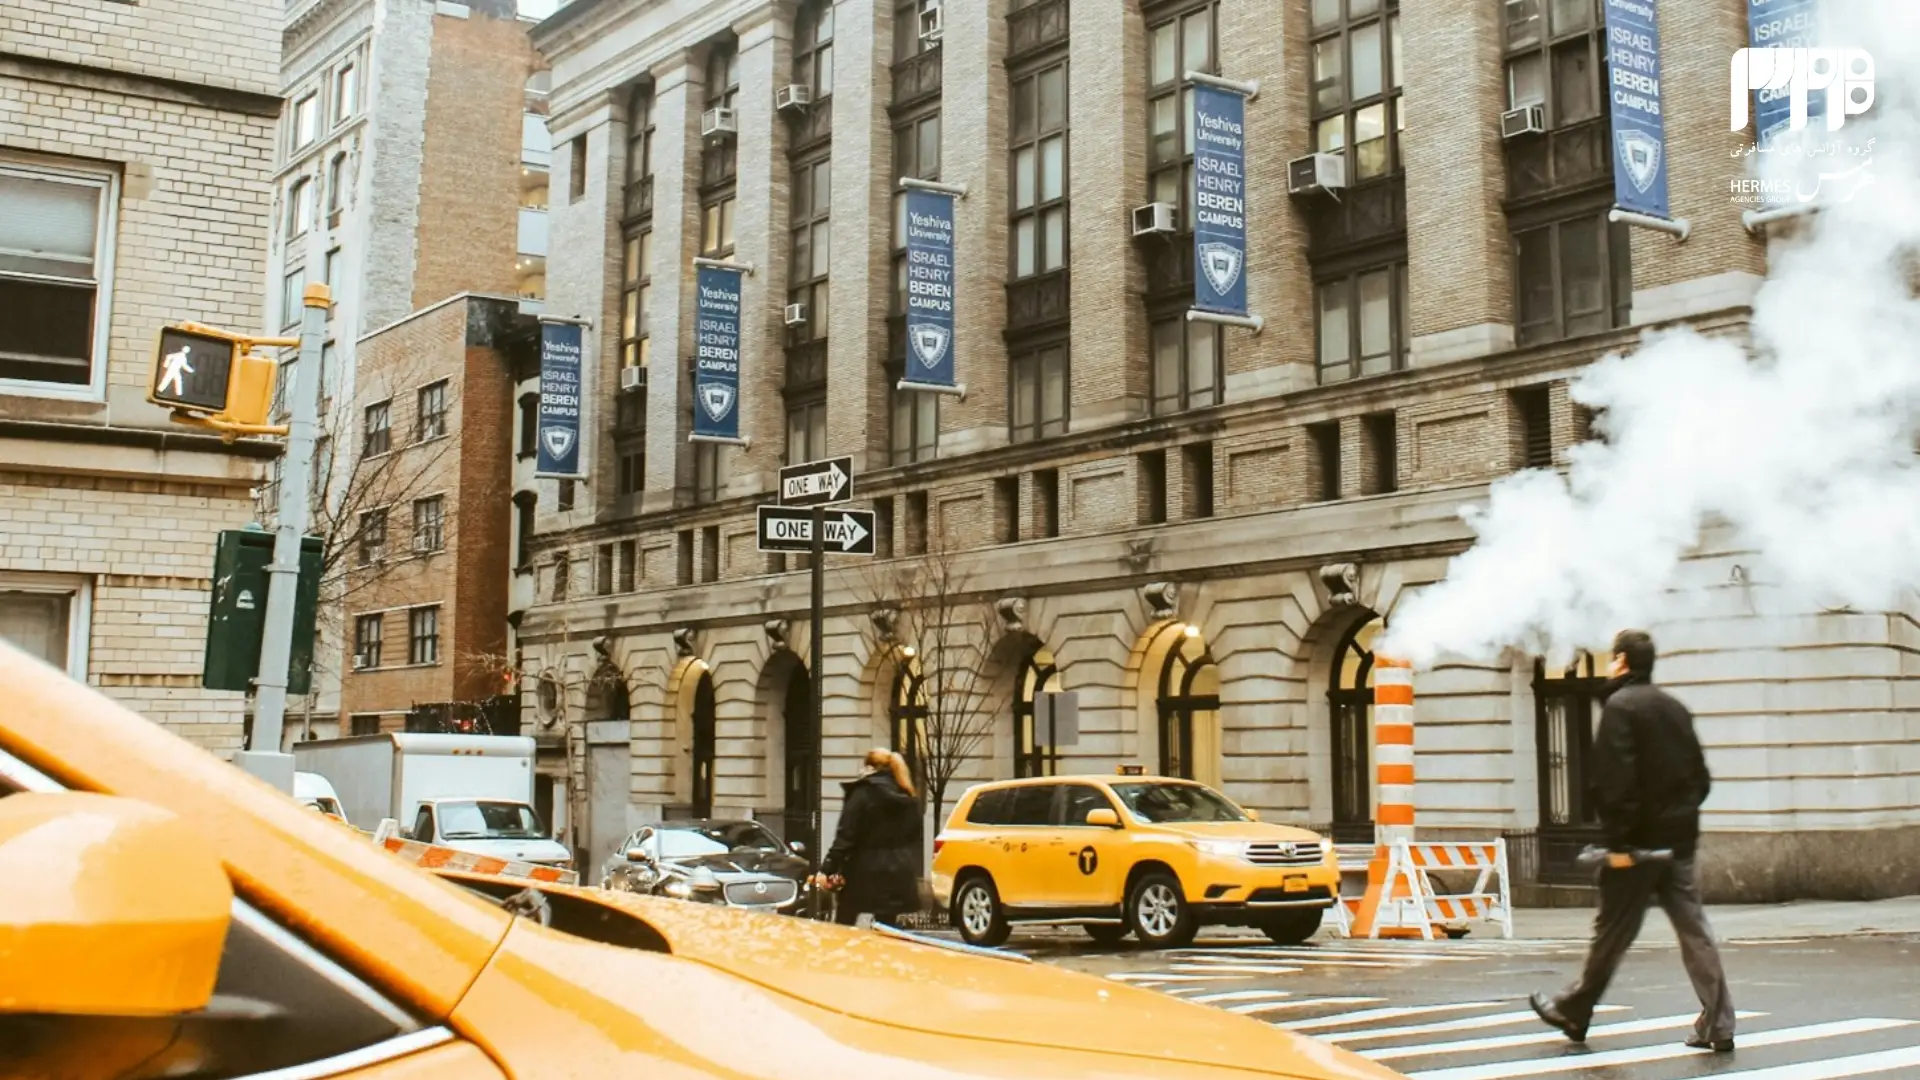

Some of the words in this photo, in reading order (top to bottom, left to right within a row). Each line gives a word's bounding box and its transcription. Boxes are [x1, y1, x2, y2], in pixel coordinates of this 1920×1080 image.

[1755, 12, 1815, 42] ISRAEL
[1611, 27, 1656, 53] ISRAEL
[1612, 47, 1656, 73] HENRY
[1613, 68, 1658, 96] BEREN
[1614, 91, 1660, 115] CAMPUS
[1198, 112, 1242, 134] Yeshiva
[1197, 129, 1241, 150] University
[1198, 157, 1242, 178] ISRAEL
[1198, 176, 1241, 195] HENRY
[1198, 193, 1242, 213] BEREN
[910, 211, 951, 230] Yeshiva
[1198, 210, 1243, 229] CAMPUS
[909, 227, 951, 244] University
[910, 250, 951, 266] ISRAEL
[910, 267, 950, 281] HENRY
[701, 285, 739, 301] Yeshiva
[910, 281, 951, 298] BEREN
[700, 299, 738, 313] University
[910, 297, 951, 311] CAMPUS
[700, 320, 737, 333] ISRAEL
[544, 340, 579, 354] Yeshiva
[700, 333, 736, 346] HENRY
[700, 346, 737, 360] BEREN
[699, 359, 737, 372] CAMPUS
[543, 371, 578, 383] ISRAEL
[542, 382, 577, 393] HENRY
[542, 393, 578, 405] BEREN
[542, 406, 577, 416] CAMPUS
[788, 477, 809, 495] ONE
[818, 473, 840, 491] WAY
[776, 521, 809, 538] ONE
[825, 523, 857, 540] WAY
